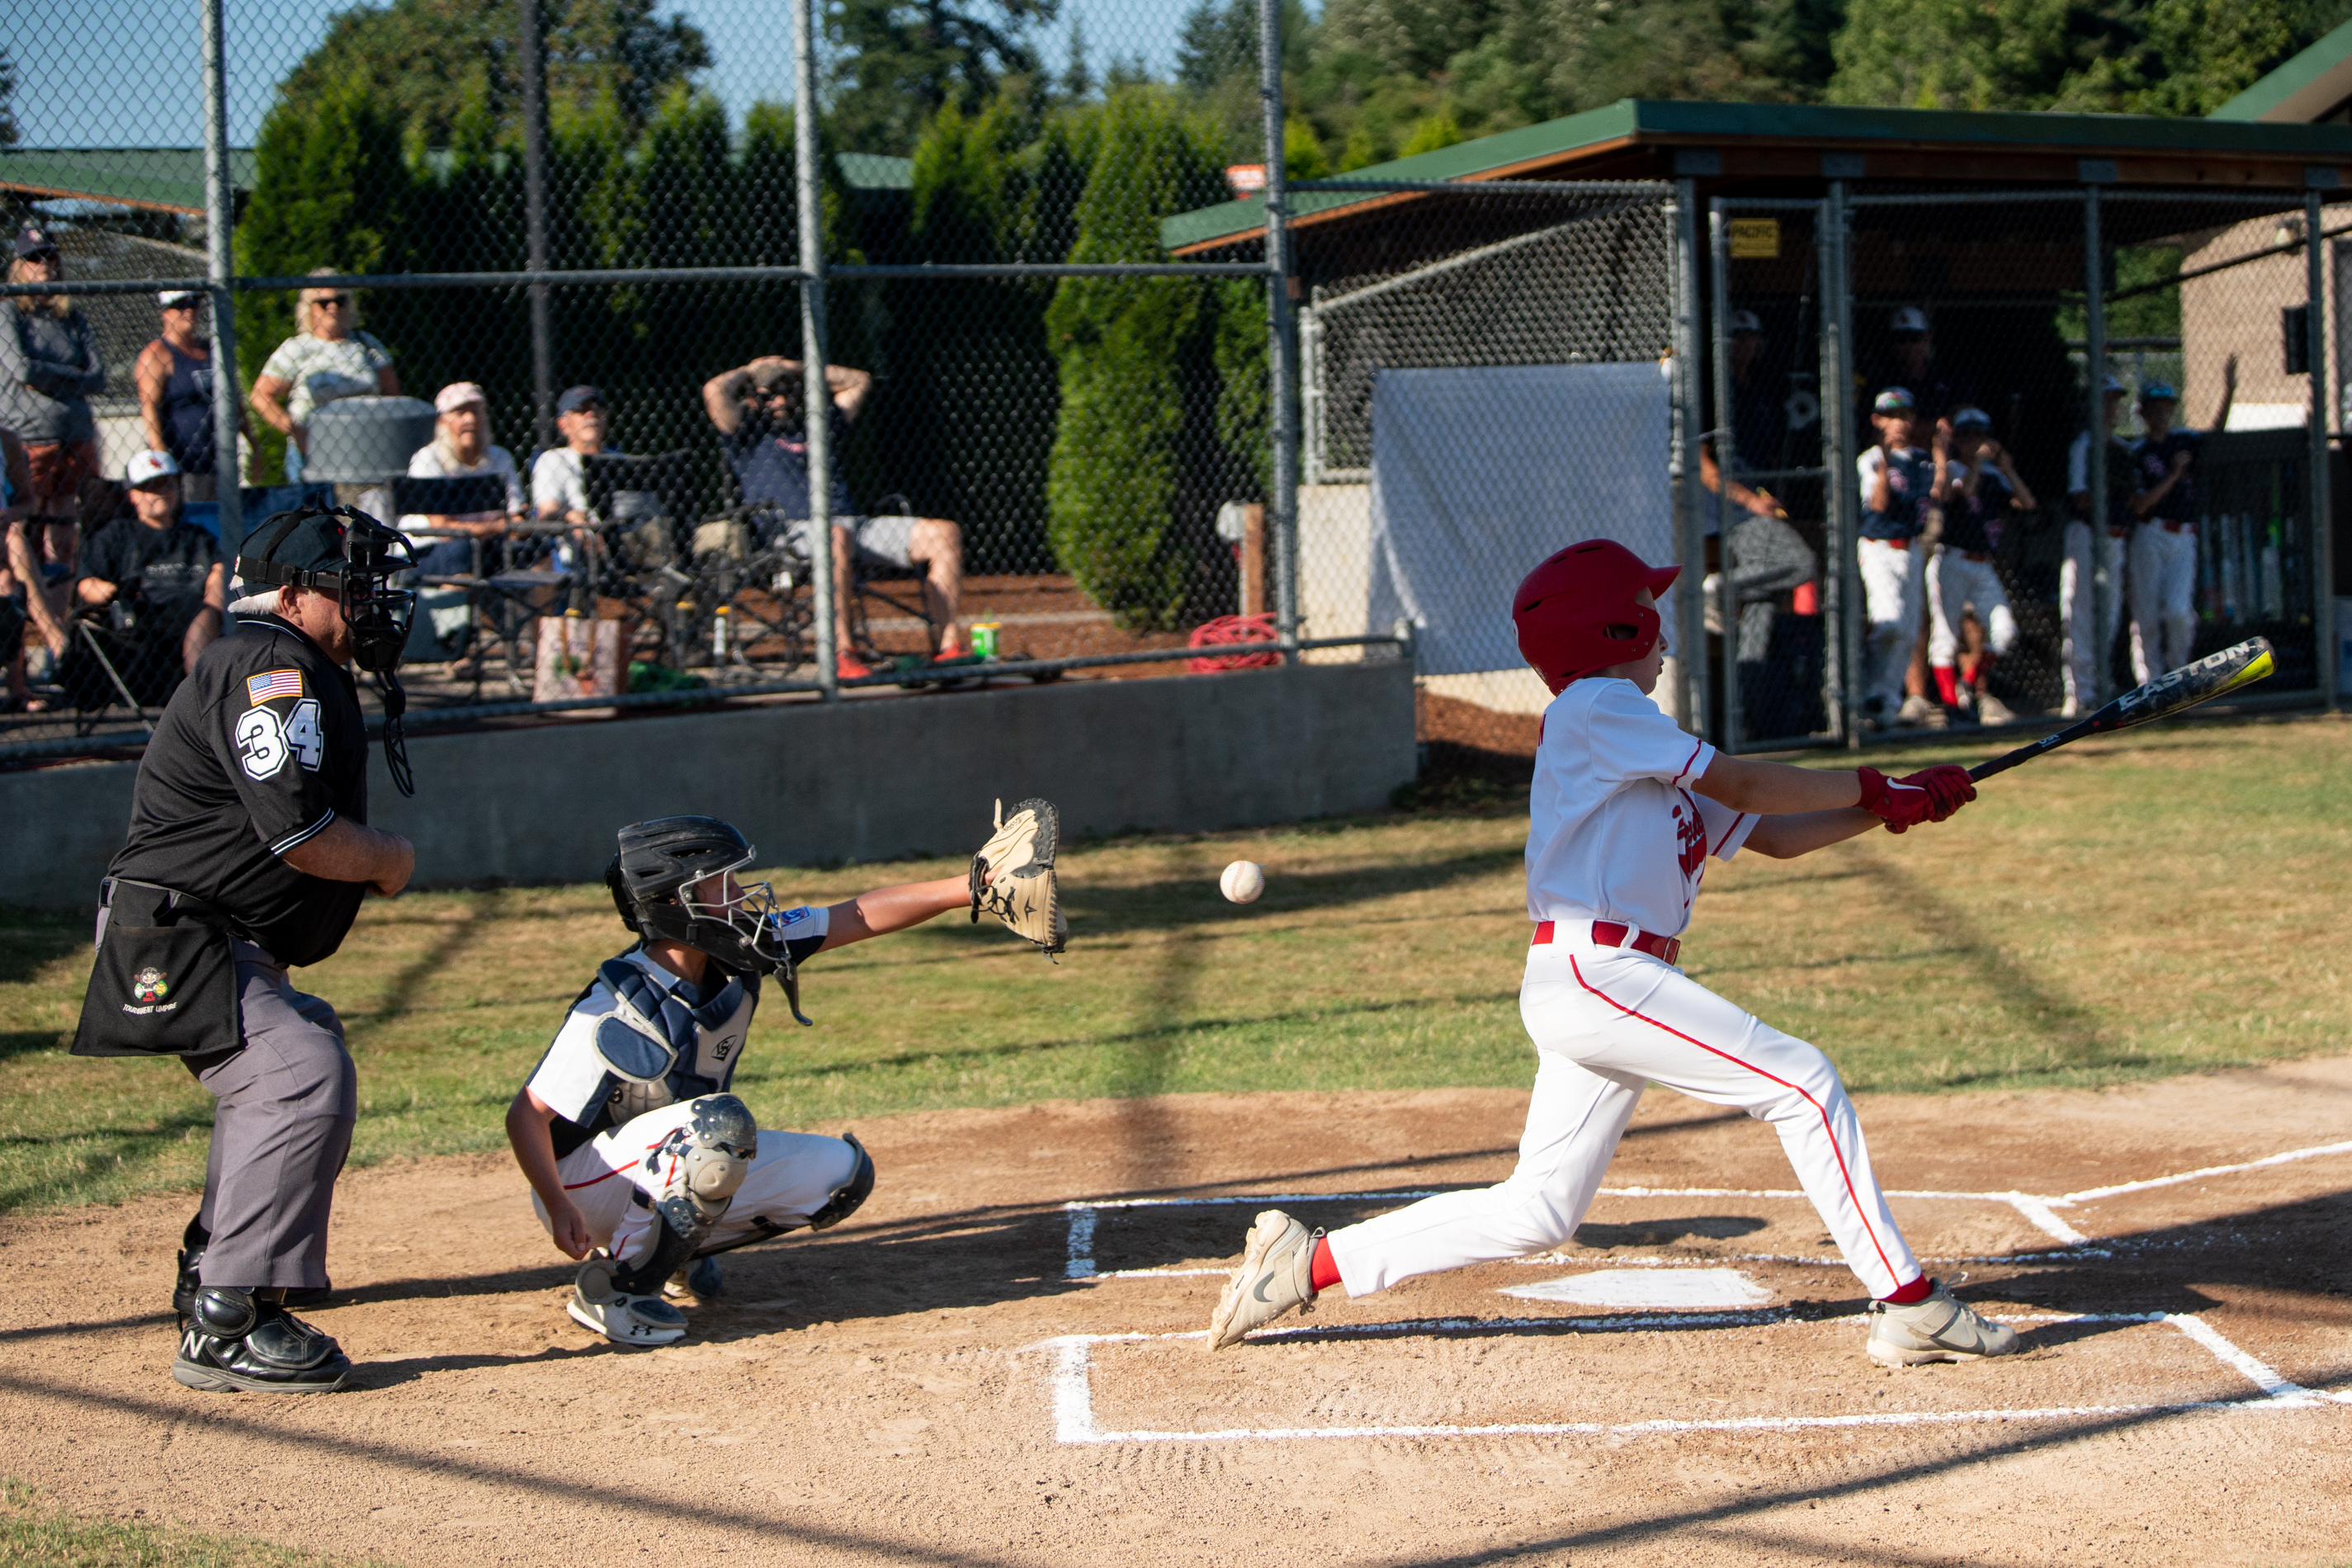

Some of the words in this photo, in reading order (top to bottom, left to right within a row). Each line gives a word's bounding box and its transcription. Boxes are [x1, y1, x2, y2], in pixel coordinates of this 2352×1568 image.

[2118, 641, 2250, 711] EASTON
[234, 698, 324, 782] 34
[181, 1329, 208, 1359] N
